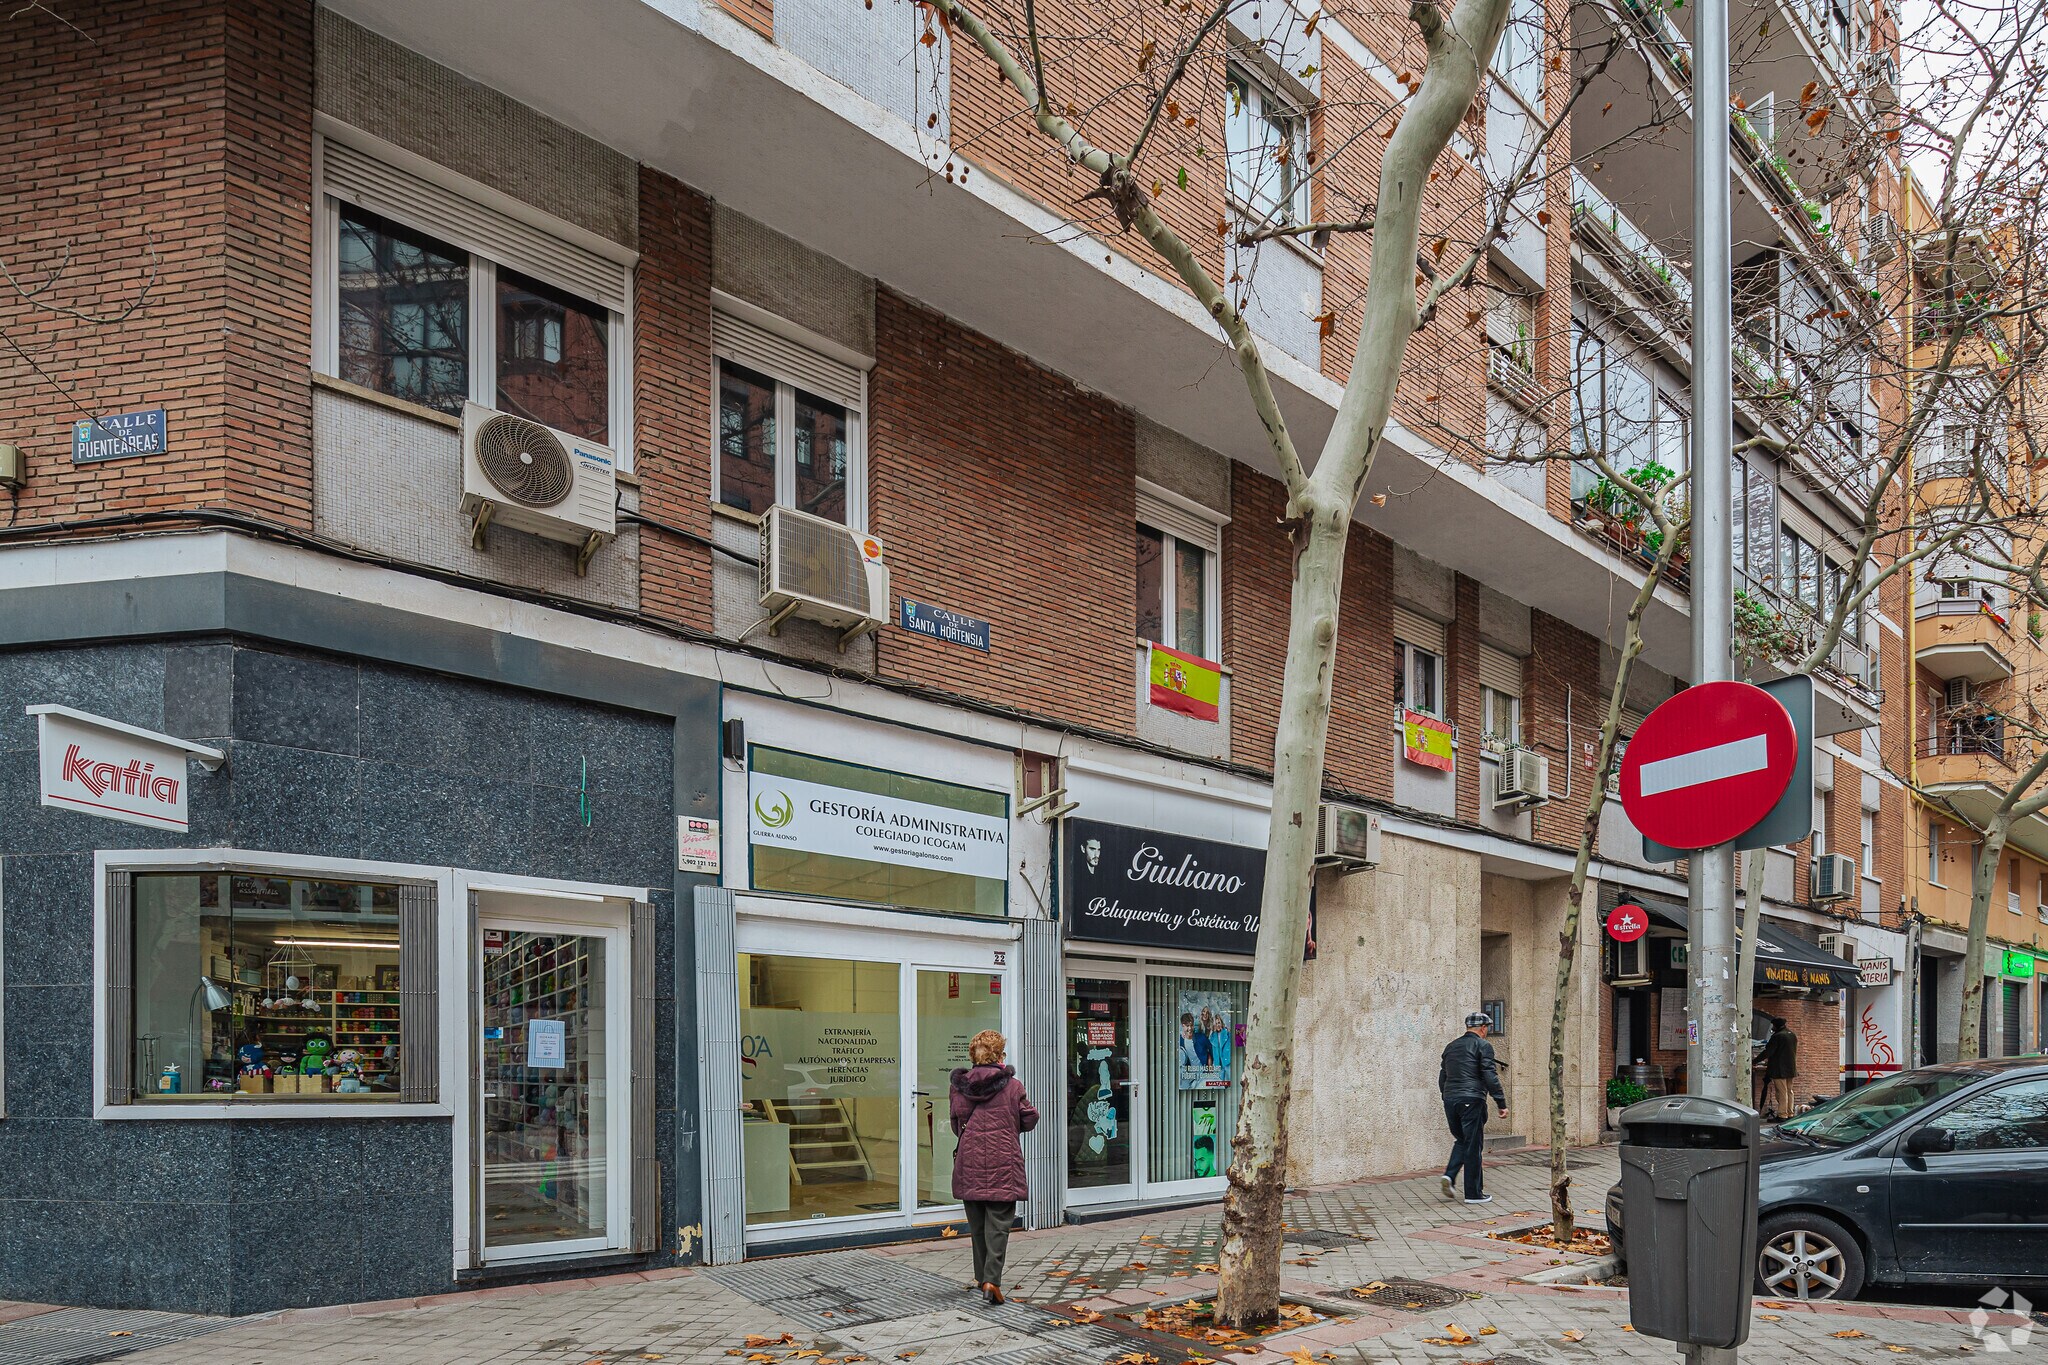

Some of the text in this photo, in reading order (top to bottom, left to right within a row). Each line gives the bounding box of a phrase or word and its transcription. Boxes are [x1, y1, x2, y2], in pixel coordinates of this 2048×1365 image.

[98, 413, 156, 430] CALLE
[119, 428, 132, 437] DE
[78, 433, 159, 459] PUENTEAREAS
[574, 448, 611, 465] Panasonic
[582, 463, 610, 475] INVERTER
[933, 609, 976, 628] CALLE
[948, 621, 959, 629] DE
[909, 616, 984, 648] SANTA HORTENSIA
[62, 743, 179, 804] katia
[809, 799, 1005, 845] GESTORÍA ADMINISTRATIVA
[753, 830, 798, 842] GUERRA ALONSO
[856, 825, 966, 852] COLEGIADO ICOGAM
[873, 844, 954, 862] www.gestoriagalonso.com
[1127, 842, 1245, 894] Giuliano
[1085, 896, 1173, 927] Peluquería
[1168, 913, 1185, 931] y
[1187, 908, 1241, 932] Estética
[1613, 923, 1641, 931] Estrella
[994, 954, 1005, 963] 22
[1671, 946, 1688, 964] CE
[1860, 960, 1888, 971] NANIS
[1810, 972, 1831, 985] NANIS
[1861, 972, 1888, 983] ATERIA
[824, 1028, 872, 1037] EXTRANJERÍA
[818, 1038, 878, 1046] NACIONALIDAD
[832, 1046, 864, 1055] TRÁFICO
[798, 1055, 851, 1064] AUTÓNOMOS
[827, 1066, 869, 1074] HERENCIAS
[830, 1074, 867, 1083] JURÍDICO
